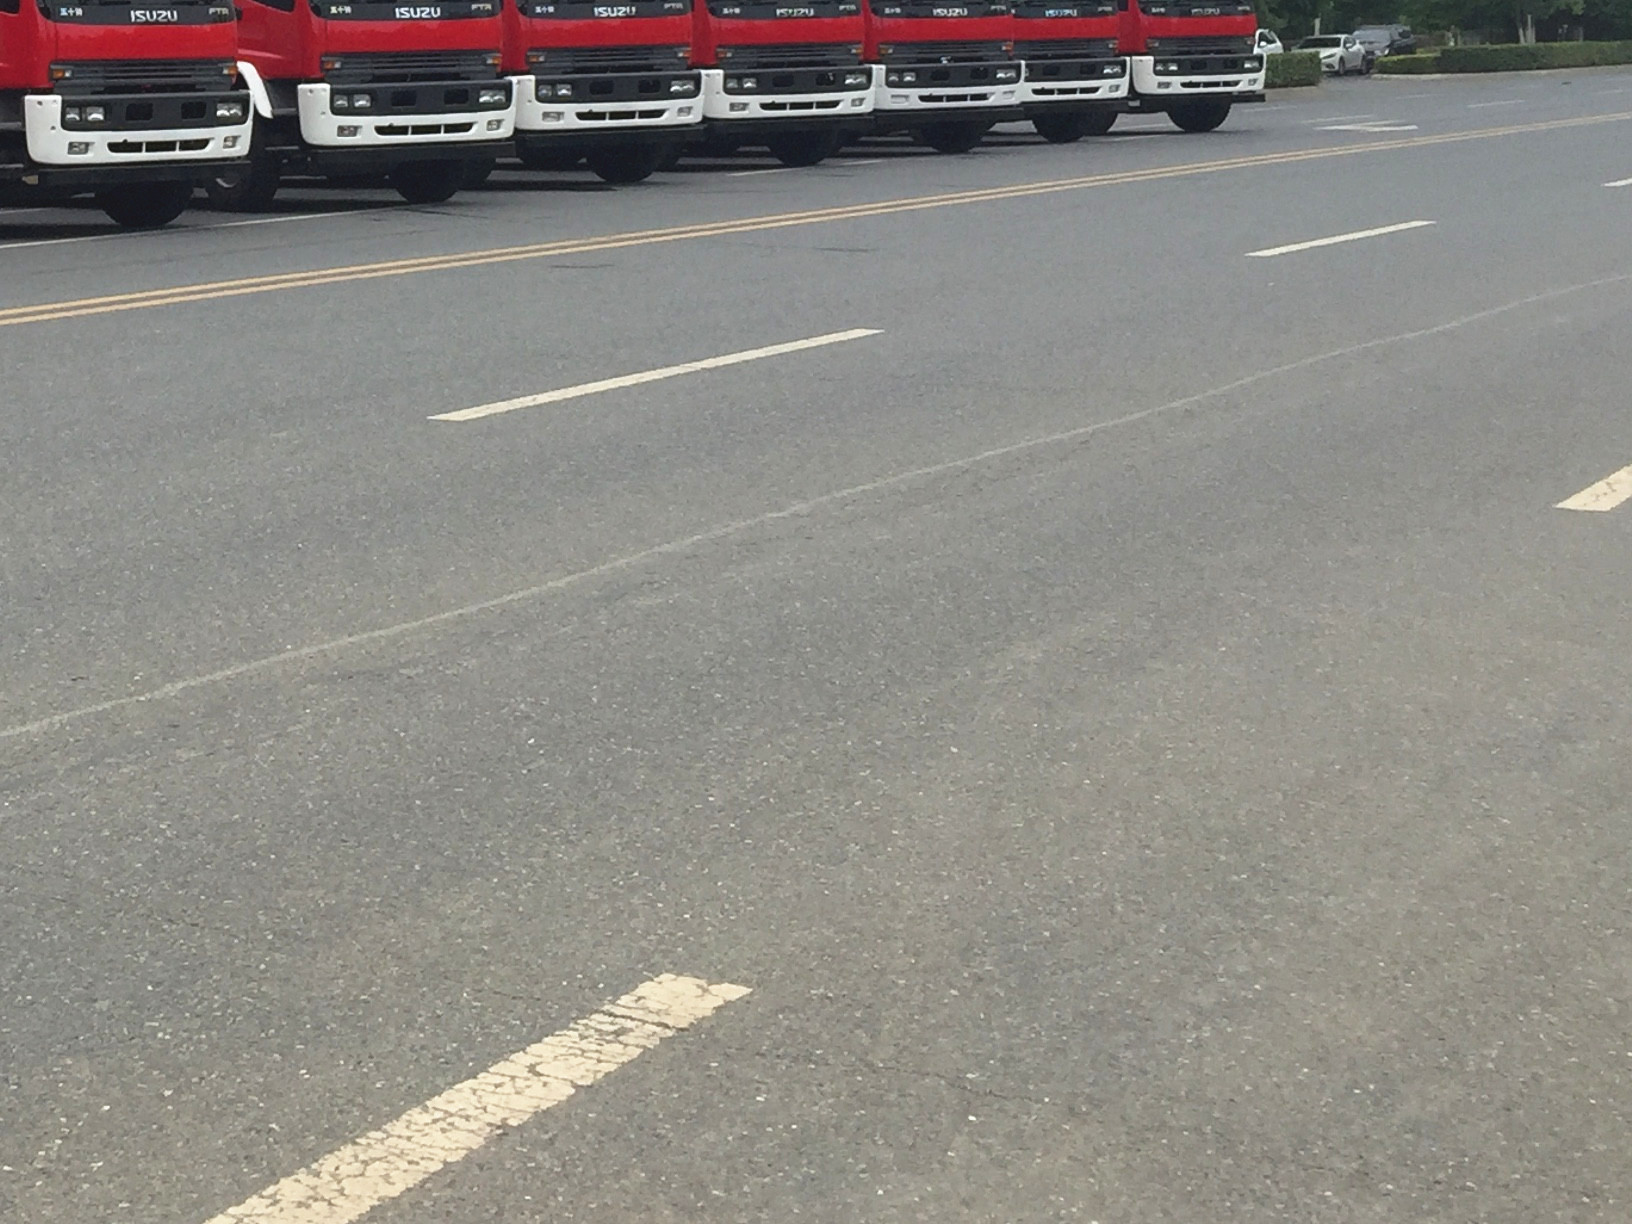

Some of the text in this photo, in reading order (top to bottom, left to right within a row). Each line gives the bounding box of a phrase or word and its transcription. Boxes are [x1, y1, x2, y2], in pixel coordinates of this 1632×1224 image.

[130, 9, 178, 23] ISUZU
[394, 6, 441, 19] ISUZU
[593, 5, 636, 18] ISUZU
[776, 7, 815, 17] ISUZU
[932, 7, 968, 18] ISUZU
